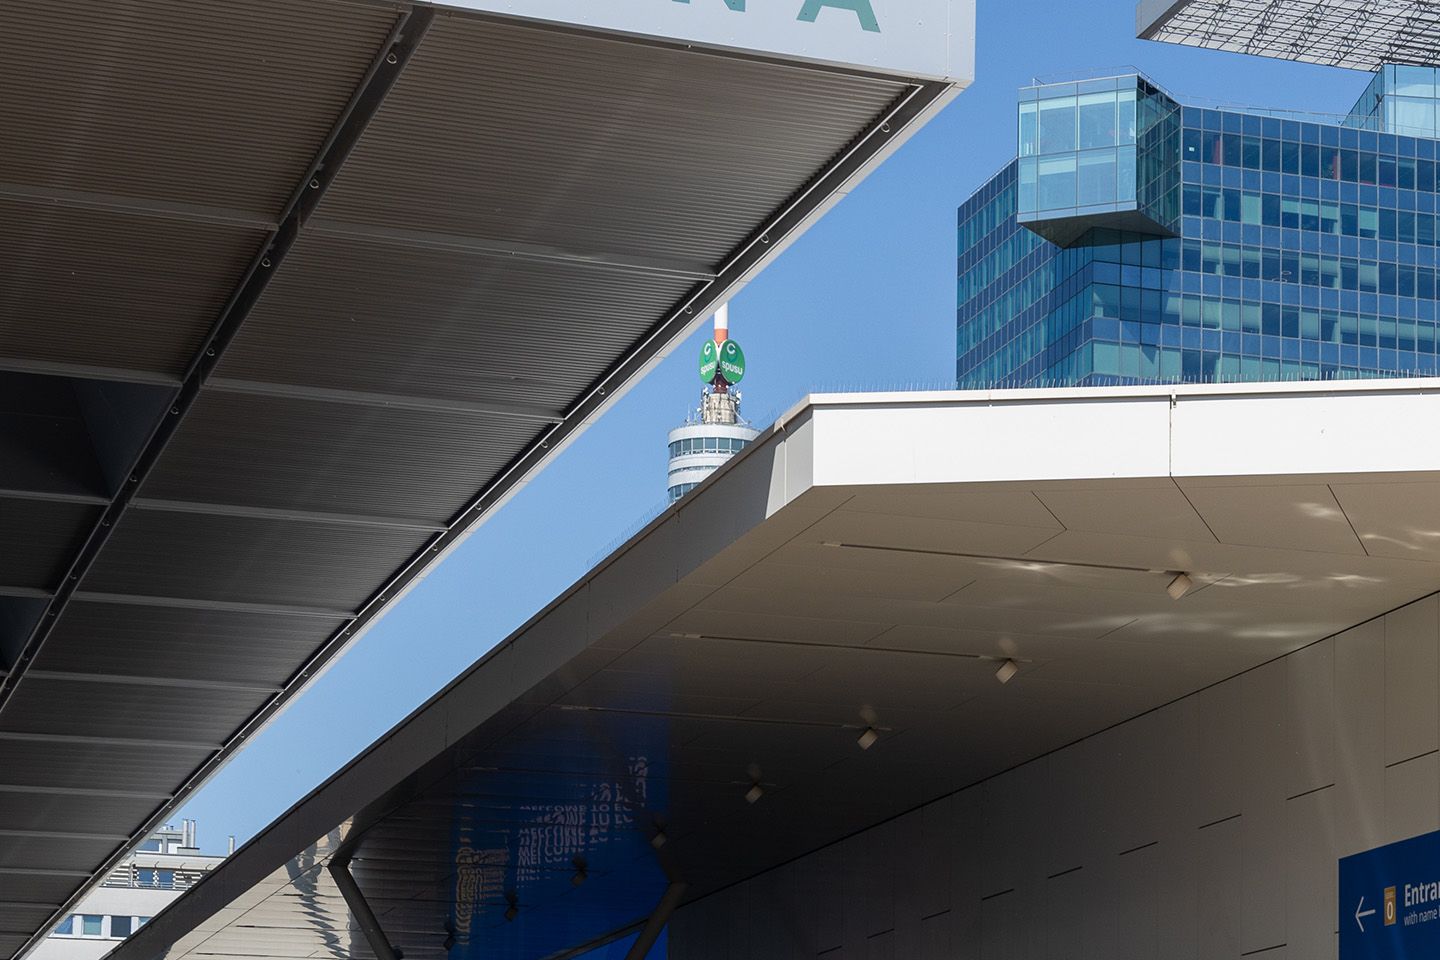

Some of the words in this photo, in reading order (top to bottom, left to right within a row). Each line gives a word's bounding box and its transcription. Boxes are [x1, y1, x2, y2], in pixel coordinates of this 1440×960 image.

[721, 361, 743, 375] spusu
[1386, 902, 1394, 920] 0
[1404, 911, 1418, 926] with
[1419, 909, 1437, 922] name
